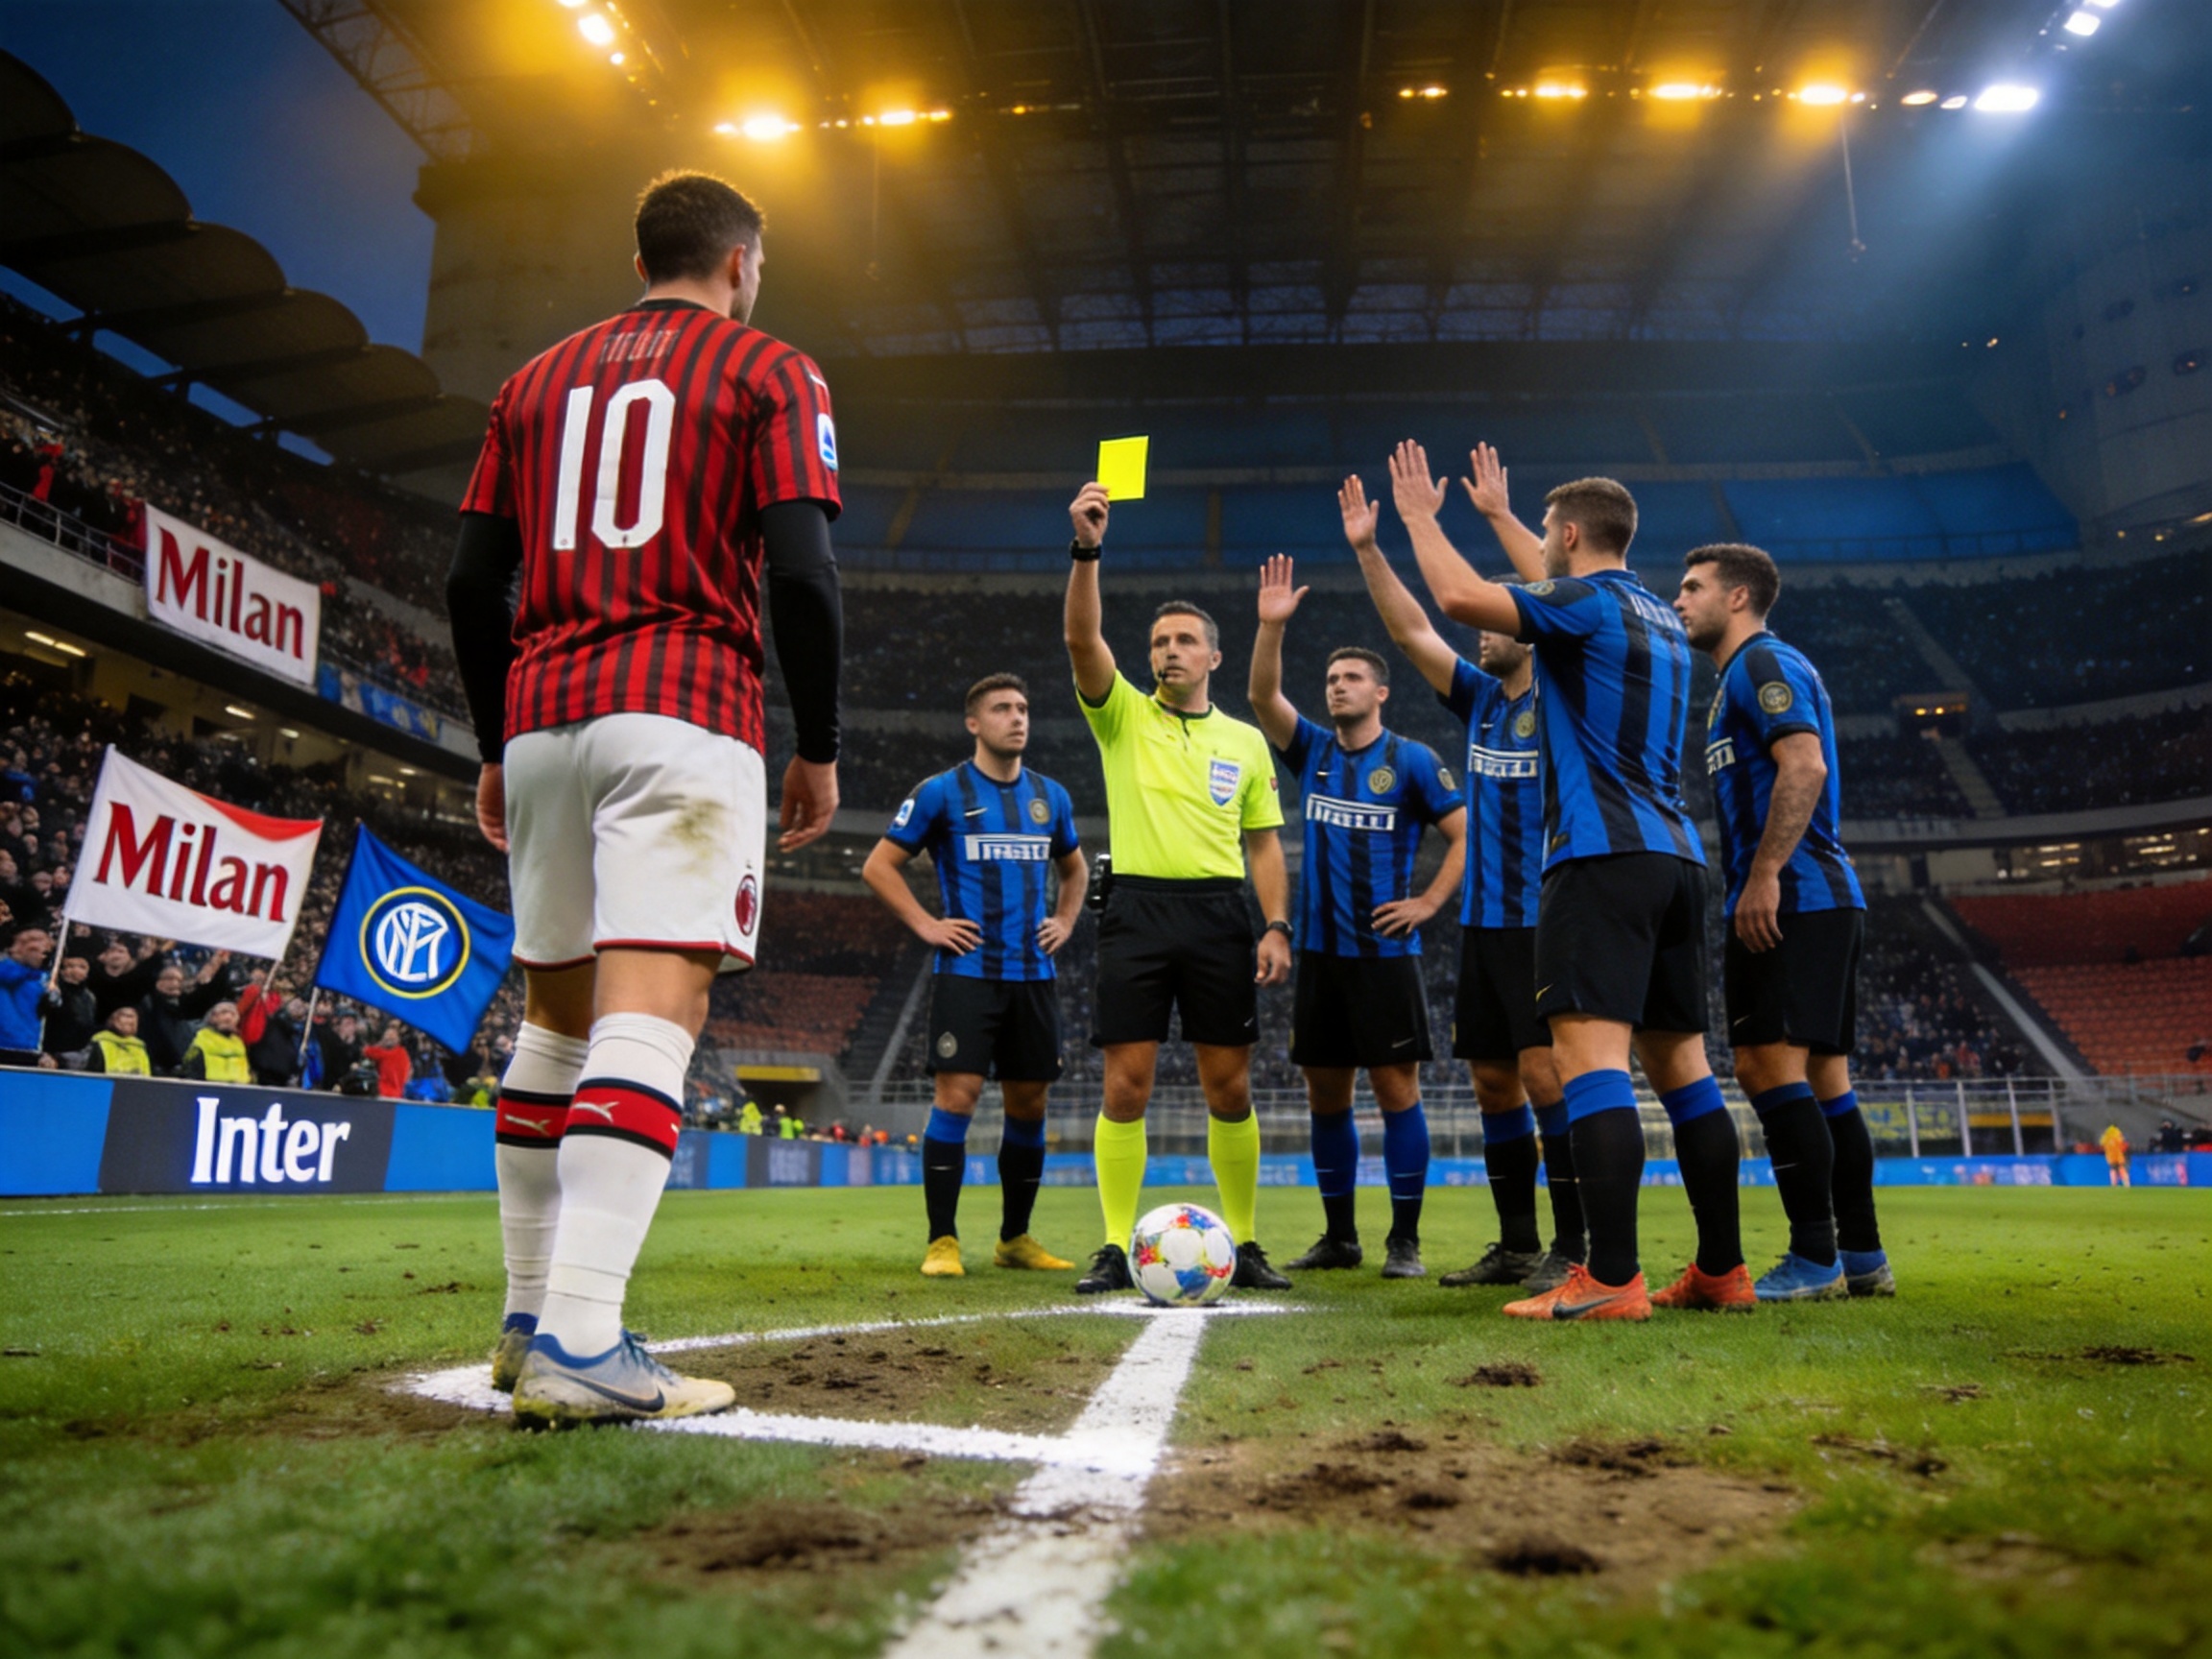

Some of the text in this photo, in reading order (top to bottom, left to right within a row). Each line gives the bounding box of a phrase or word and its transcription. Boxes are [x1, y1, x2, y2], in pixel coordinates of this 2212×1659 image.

[552, 378, 676, 551] 10
[156, 529, 304, 660] Milan
[93, 802, 290, 924] Milan
[191, 1096, 351, 1185] Inter
